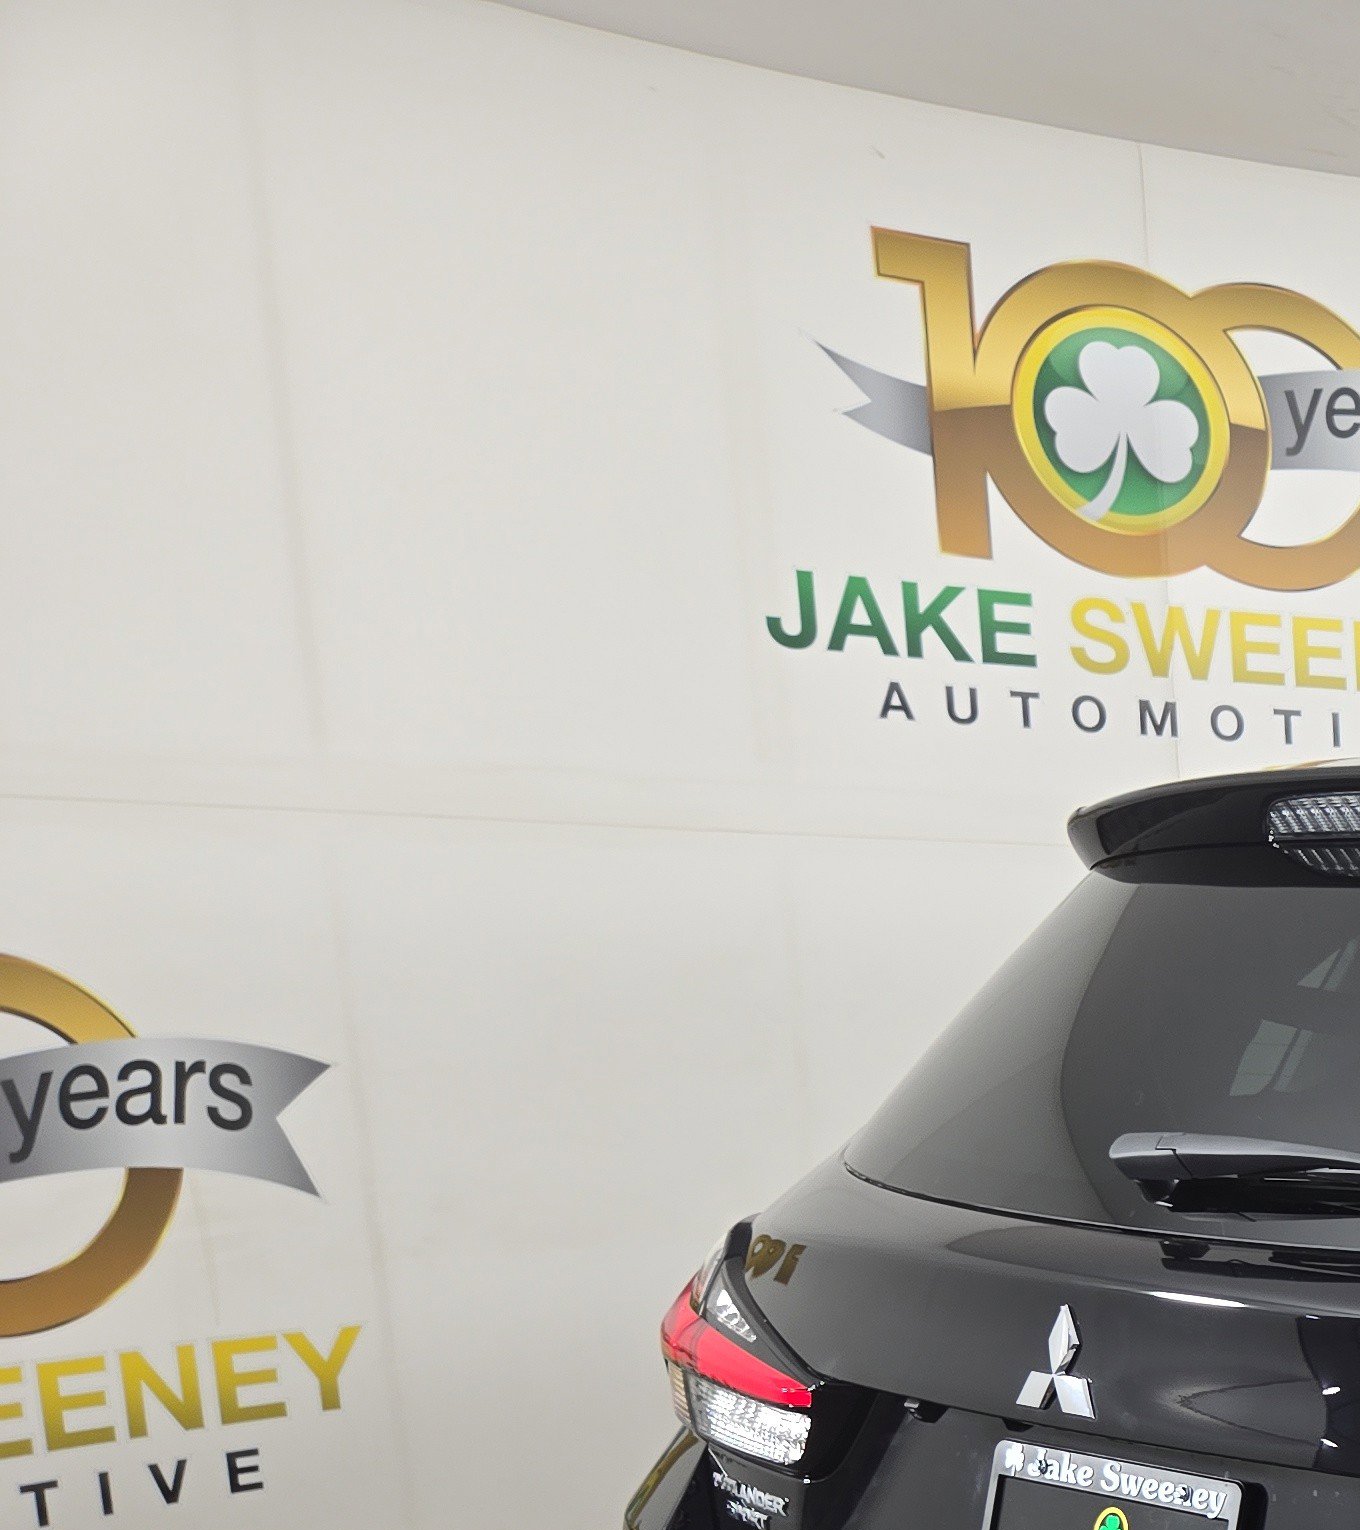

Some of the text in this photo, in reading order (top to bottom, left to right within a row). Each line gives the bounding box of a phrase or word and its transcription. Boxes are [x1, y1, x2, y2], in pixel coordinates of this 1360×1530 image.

[766, 570, 1037, 668] JAKE
[1, 1059, 253, 1164] years
[1027, 1449, 1227, 1518] Jake Sweeney
